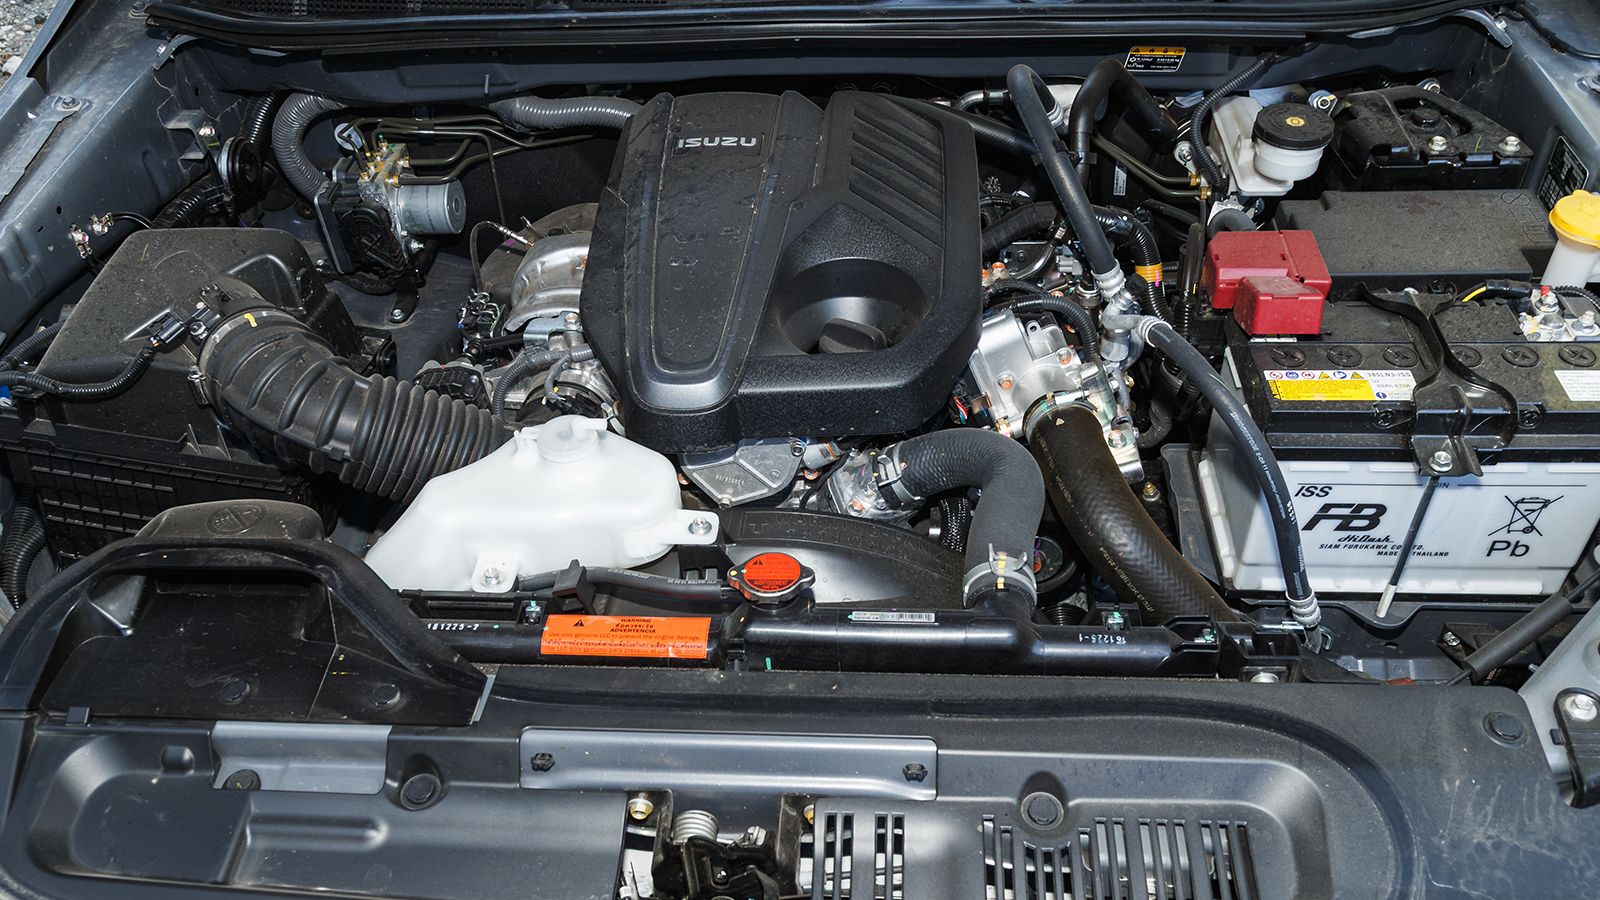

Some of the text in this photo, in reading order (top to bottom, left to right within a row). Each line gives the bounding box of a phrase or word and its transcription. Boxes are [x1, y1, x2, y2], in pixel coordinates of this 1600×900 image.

[678, 136, 757, 148] ISUZU
[1294, 485, 1333, 498] ISS
[1300, 503, 1388, 532] FB
[1486, 540, 1530, 557] Pb
